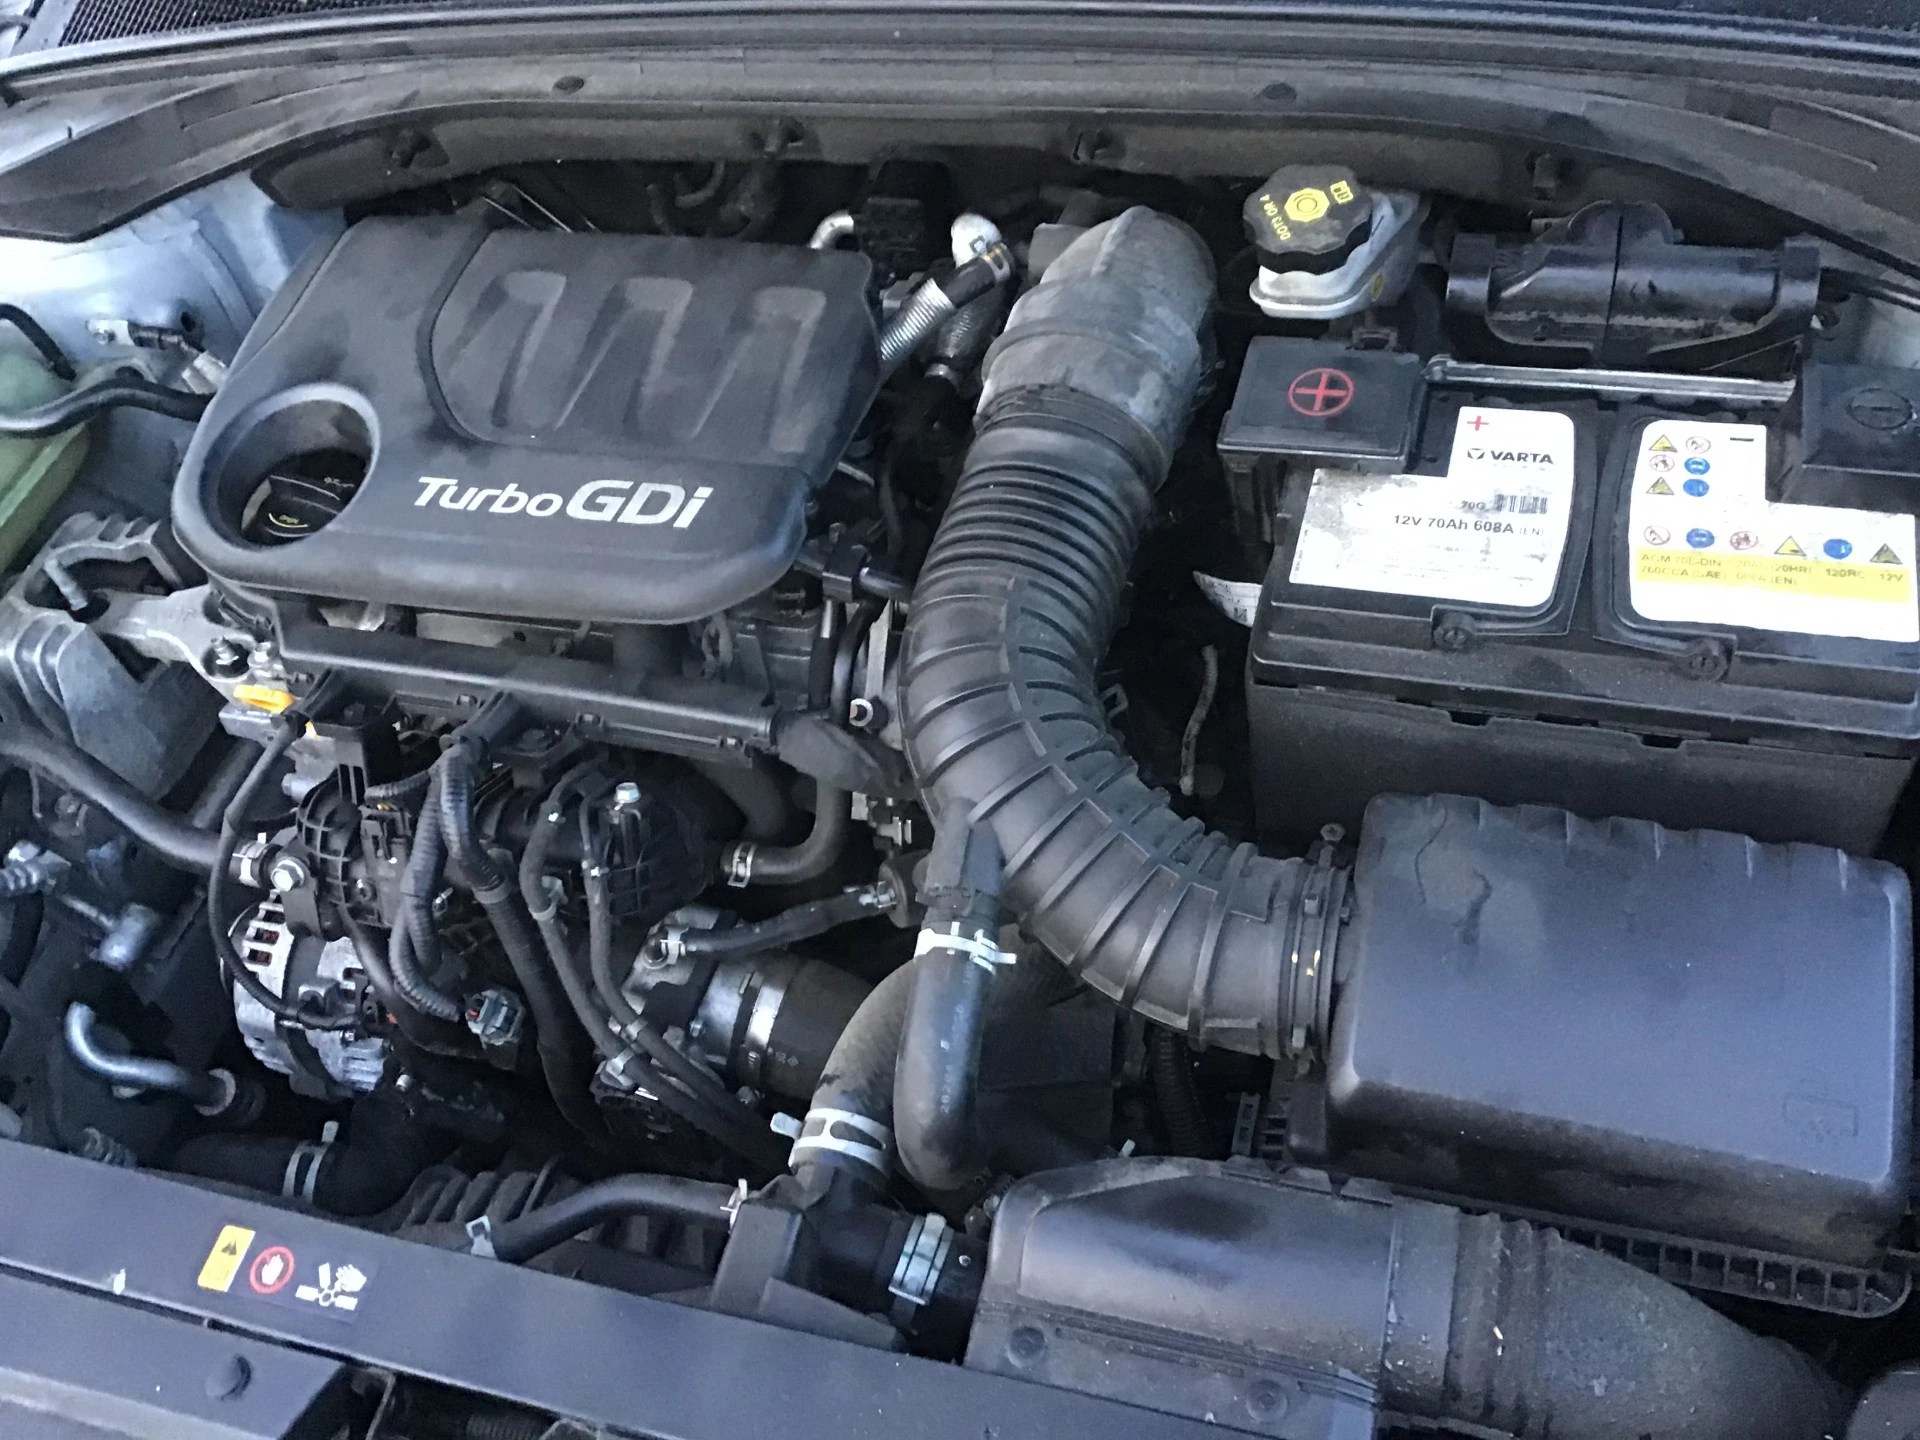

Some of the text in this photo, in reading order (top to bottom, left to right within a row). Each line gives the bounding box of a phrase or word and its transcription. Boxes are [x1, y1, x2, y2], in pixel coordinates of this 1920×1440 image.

[1264, 201, 1278, 216] OR
[1272, 217, 1291, 240] DOT3
[1491, 450, 1554, 464] VARTA
[414, 476, 714, 528] Turbo GDi
[1394, 515, 1422, 526] 12V
[1428, 518, 1468, 530] 70Ah
[1474, 520, 1514, 534] 608A
[1880, 573, 1903, 582] 12V
